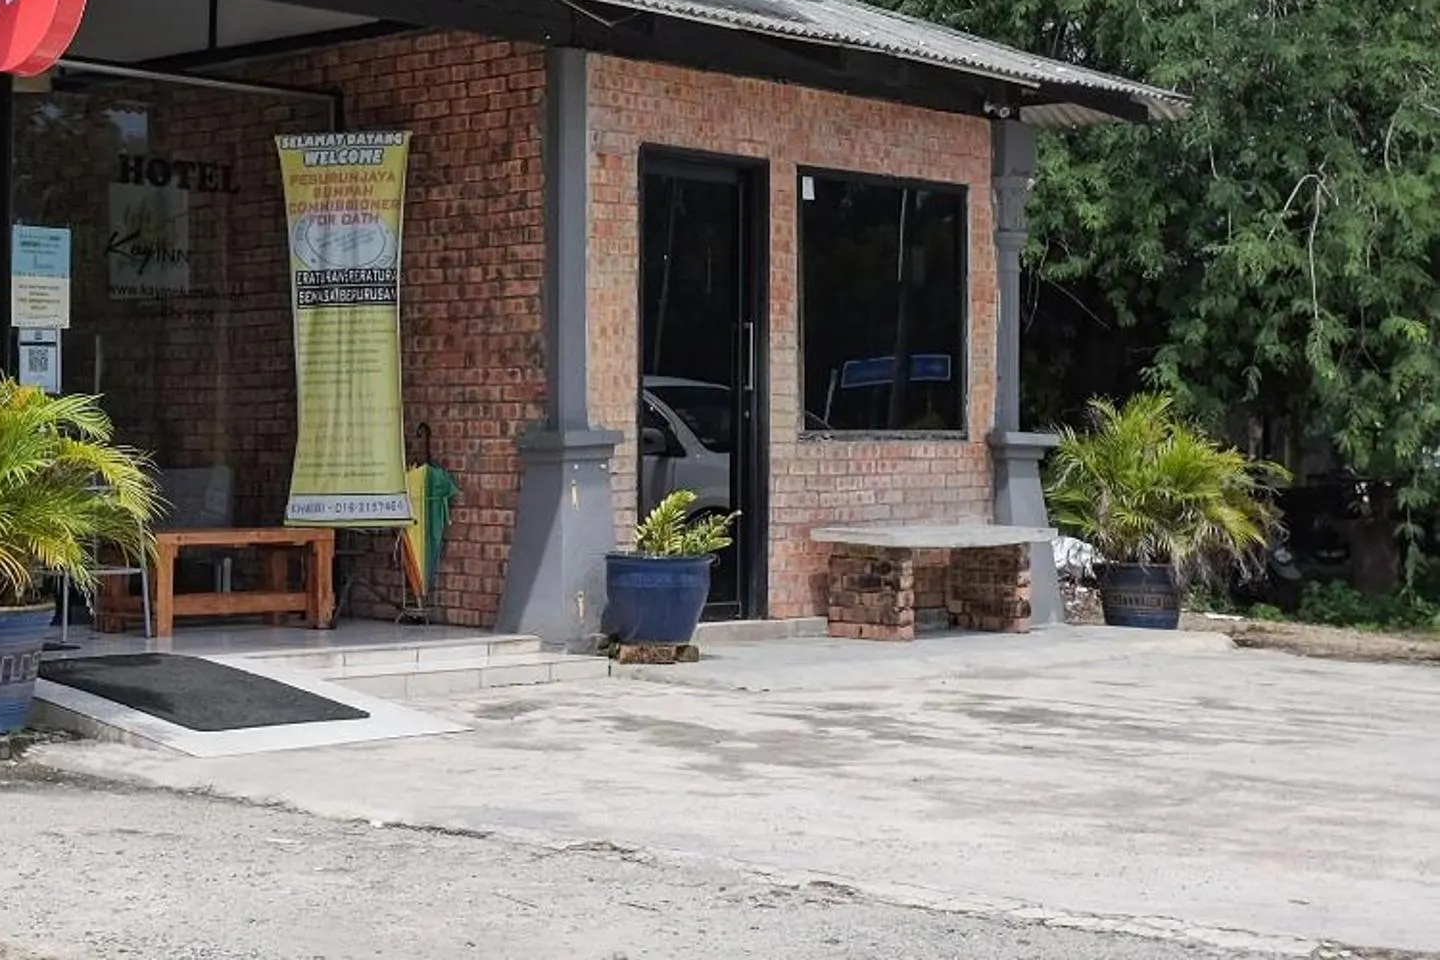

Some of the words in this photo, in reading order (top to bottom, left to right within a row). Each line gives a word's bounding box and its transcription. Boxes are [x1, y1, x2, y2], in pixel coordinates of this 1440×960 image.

[281, 133, 345, 150] SELAMAT
[346, 131, 404, 146] DATANG
[303, 148, 385, 167] WELCOME
[116, 153, 239, 194] HOTEL
